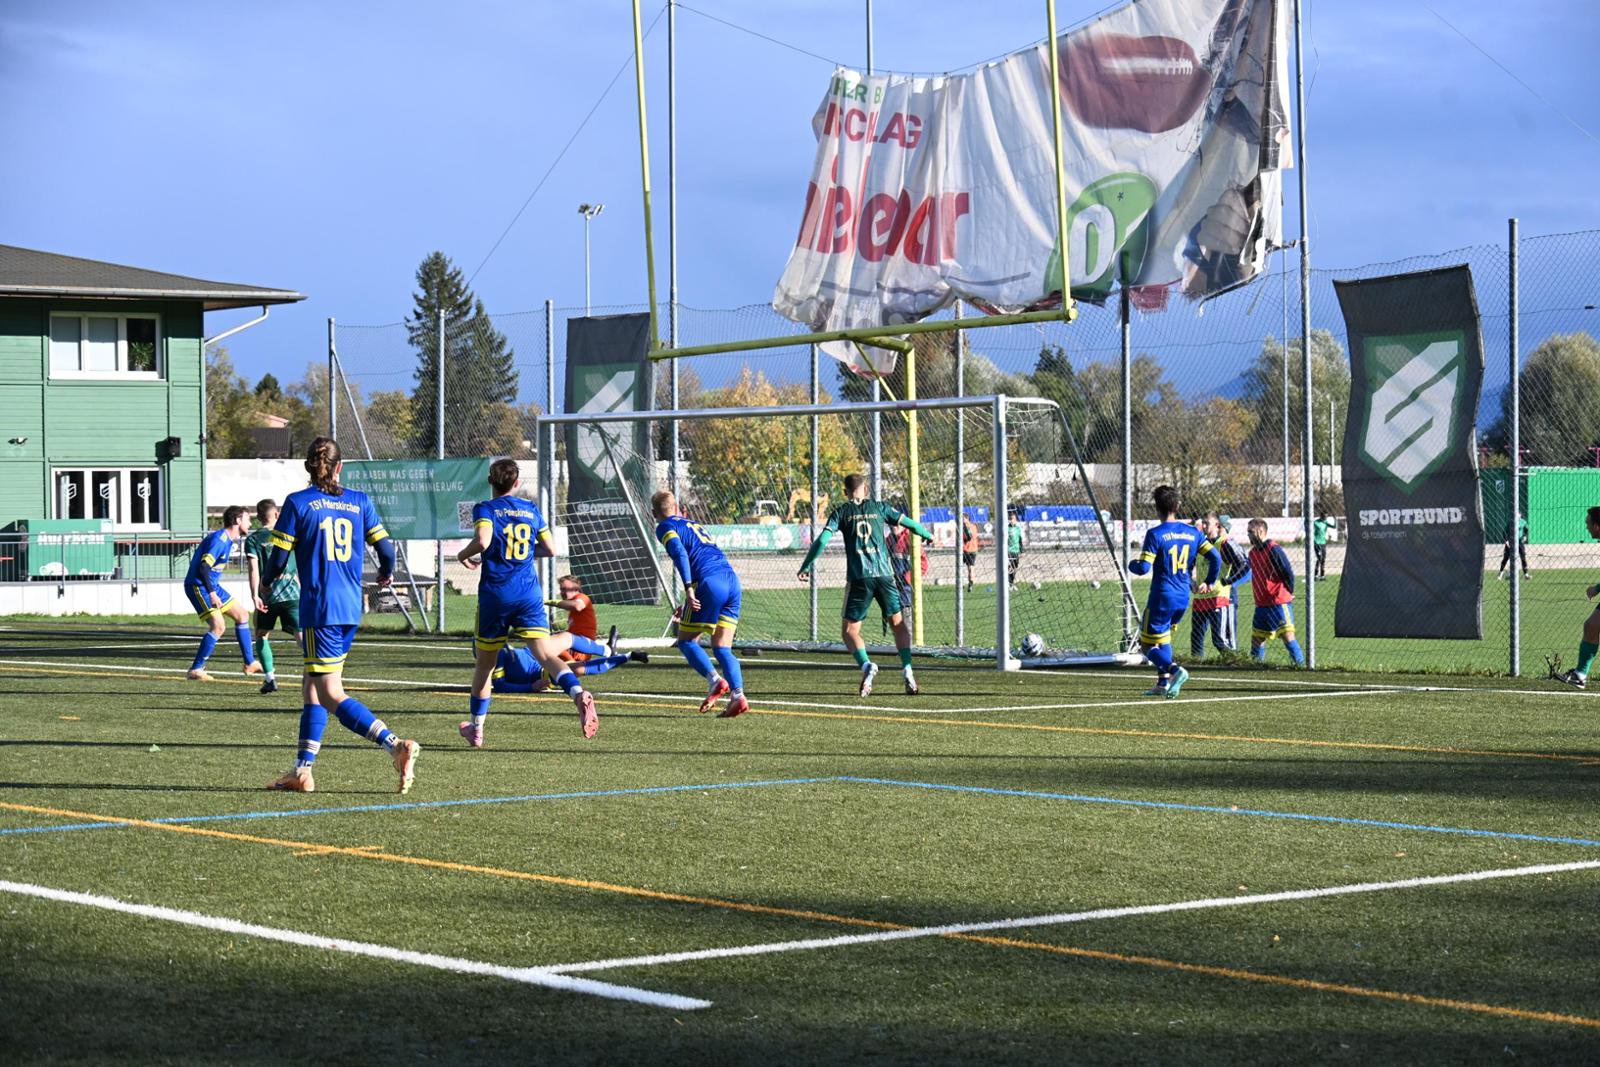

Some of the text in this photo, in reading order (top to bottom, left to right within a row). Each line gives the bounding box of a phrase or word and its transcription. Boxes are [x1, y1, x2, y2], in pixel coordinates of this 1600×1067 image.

[389, 469, 407, 479] WAS
[308, 497, 323, 512] TSV
[371, 495, 399, 505] EWALT!
[1359, 507, 1462, 526] SPORTBUND
[319, 516, 353, 563] 19
[503, 523, 531, 561] 18
[856, 520, 872, 545] 9
[1168, 543, 1190, 575] 14
